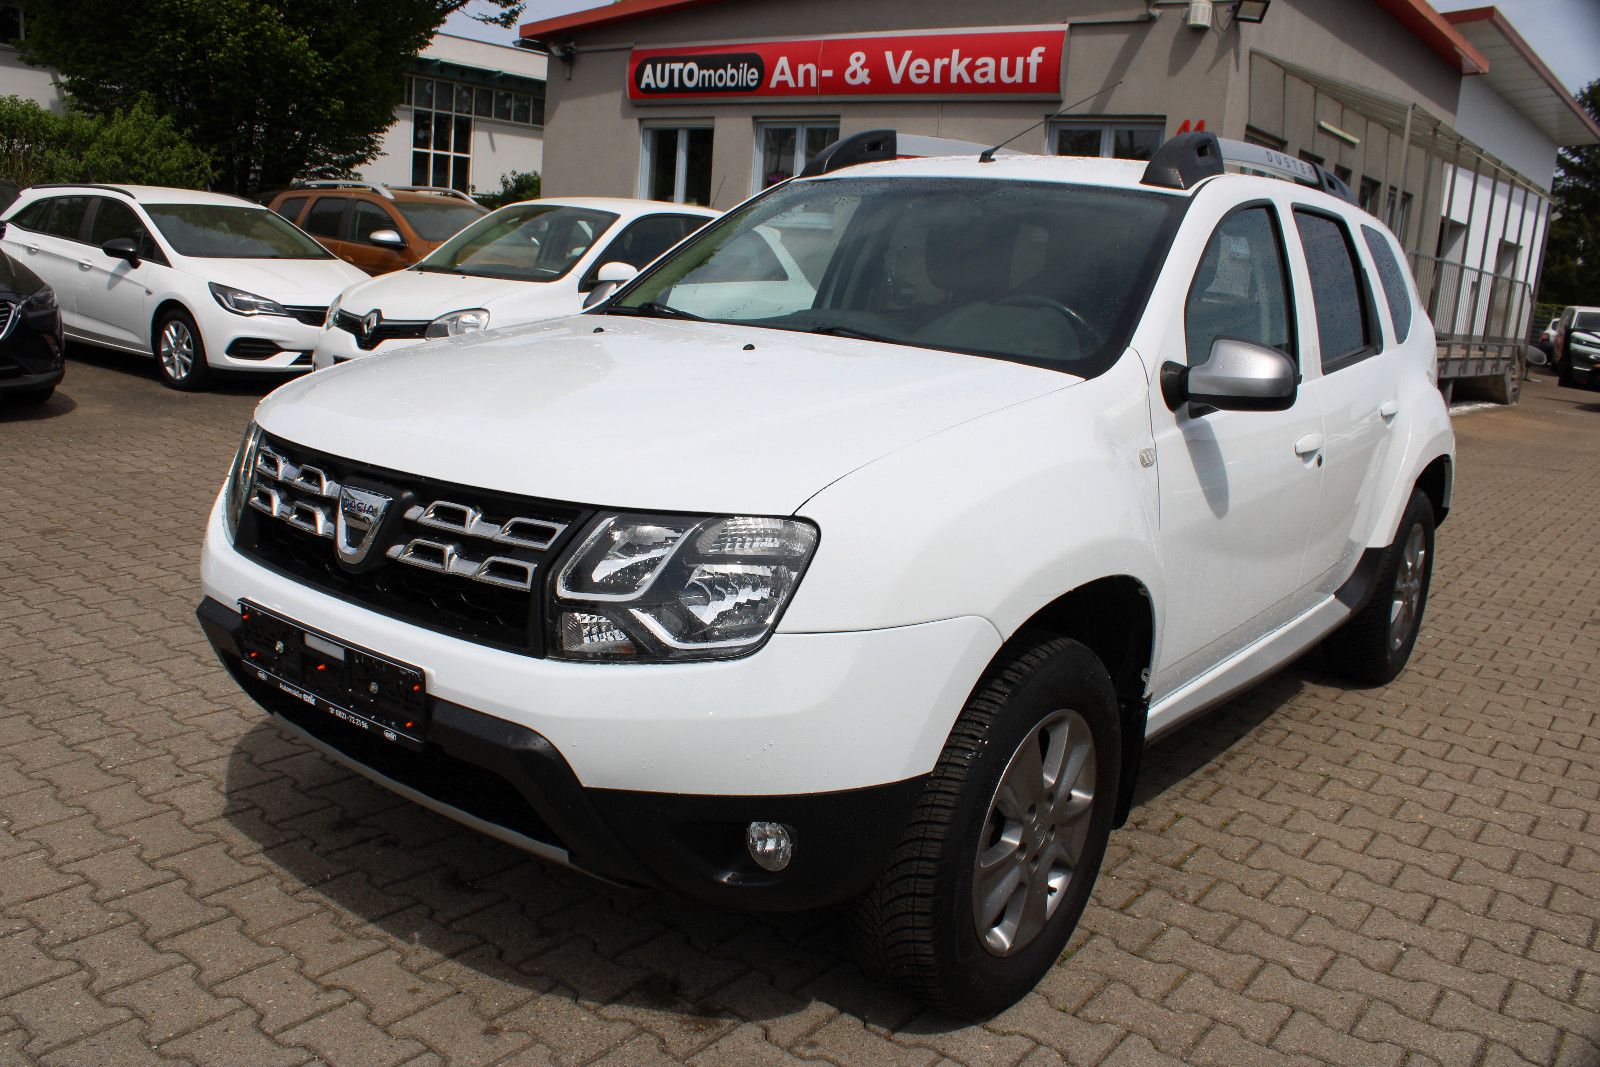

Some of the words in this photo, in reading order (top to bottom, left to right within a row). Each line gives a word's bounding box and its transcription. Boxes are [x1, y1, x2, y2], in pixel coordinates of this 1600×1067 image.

[640, 61, 759, 89] AUTOmobile
[769, 56, 834, 88] An-
[844, 51, 871, 86] &
[884, 46, 1046, 85] Verkauf
[342, 498, 375, 514] DACIA
